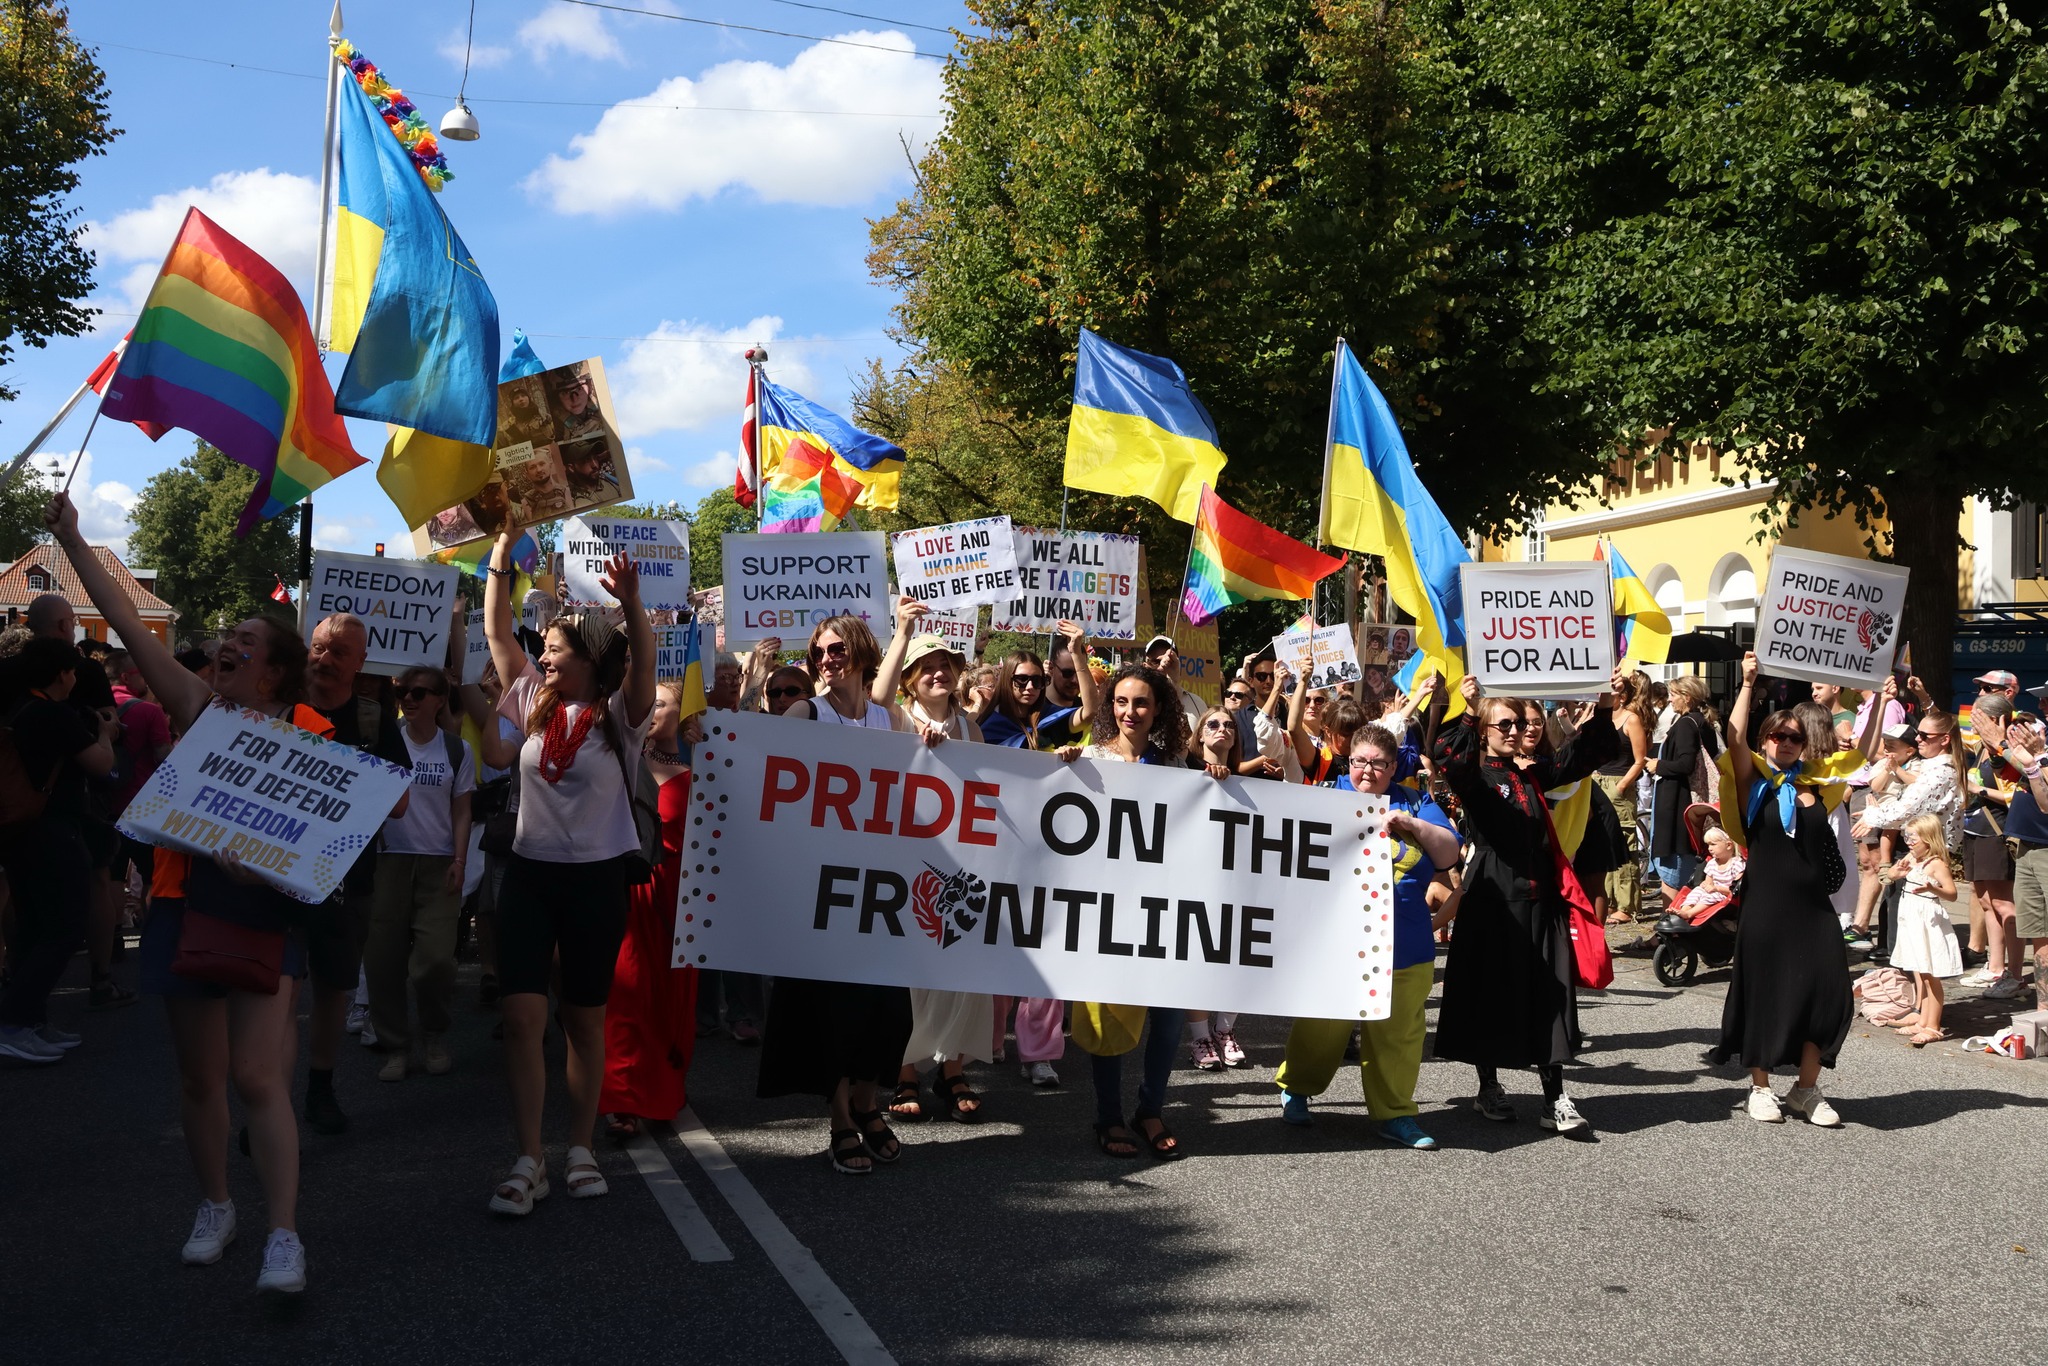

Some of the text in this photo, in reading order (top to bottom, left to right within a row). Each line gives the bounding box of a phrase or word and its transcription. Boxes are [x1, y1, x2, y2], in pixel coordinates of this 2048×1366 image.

[506, 453, 532, 464] military
[592, 524, 657, 541] NO PEACE
[915, 530, 990, 558] LOVE AND
[568, 541, 686, 560] WITHOUT JUSTICE
[1032, 540, 1104, 566] WE ALL
[742, 555, 870, 576] SUPPORT
[924, 552, 990, 578] UKRAINE
[324, 568, 445, 598] FREEDOM
[743, 583, 871, 601] UKRAINIAN
[906, 570, 1014, 601] MUST BE FREE
[1020, 567, 1040, 590] RE
[1048, 568, 1130, 596] TARGETS
[1782, 570, 1884, 604] PRIDE AND
[319, 593, 442, 623] EQUALITY
[1010, 596, 1027, 617] IN
[1481, 590, 1594, 608] PRIDE AND
[1777, 595, 1858, 624] JUSTICE
[1312, 631, 1336, 640] MILITARY
[1482, 616, 1596, 640] JUSTICE
[1774, 618, 1846, 645] ON THE
[470, 642, 483, 653] BLUE
[658, 650, 670, 666] IN
[1314, 641, 1330, 653] ARE
[1315, 650, 1345, 665] VOICES
[1485, 647, 1600, 672] FOR ALL
[1768, 640, 1874, 674] FRONTLINE
[1179, 656, 1204, 678] FOR
[228, 730, 359, 794] FOR THOSE
[198, 752, 351, 823] WHO DEFEND
[411, 773, 442, 786] YONE
[190, 785, 309, 844] FREEDOM
[758, 755, 1333, 882] PRIDE ON THE
[160, 808, 302, 876] WITH PRIDE
